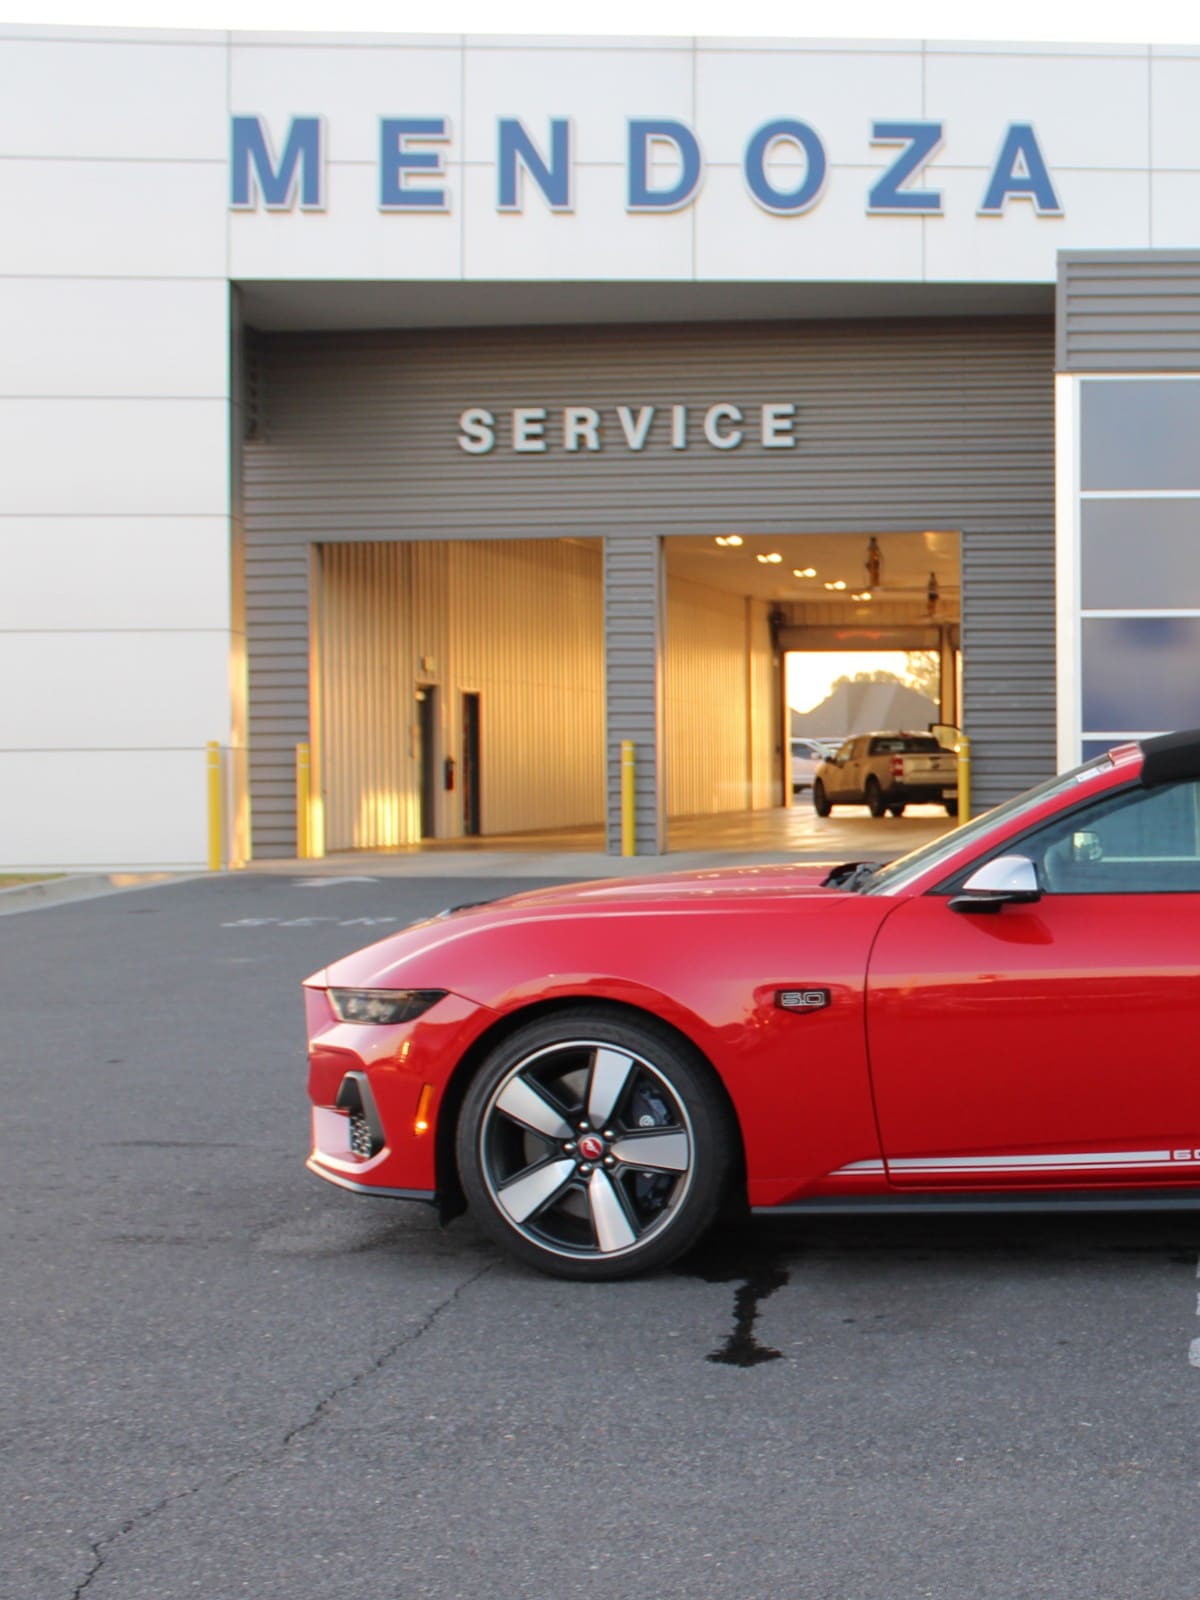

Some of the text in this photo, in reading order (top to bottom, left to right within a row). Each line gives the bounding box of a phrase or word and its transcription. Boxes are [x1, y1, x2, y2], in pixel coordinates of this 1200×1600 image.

[228, 115, 1063, 217] MENDOZA
[457, 403, 796, 453] SERVICE
[781, 991, 825, 1007] 5.0
